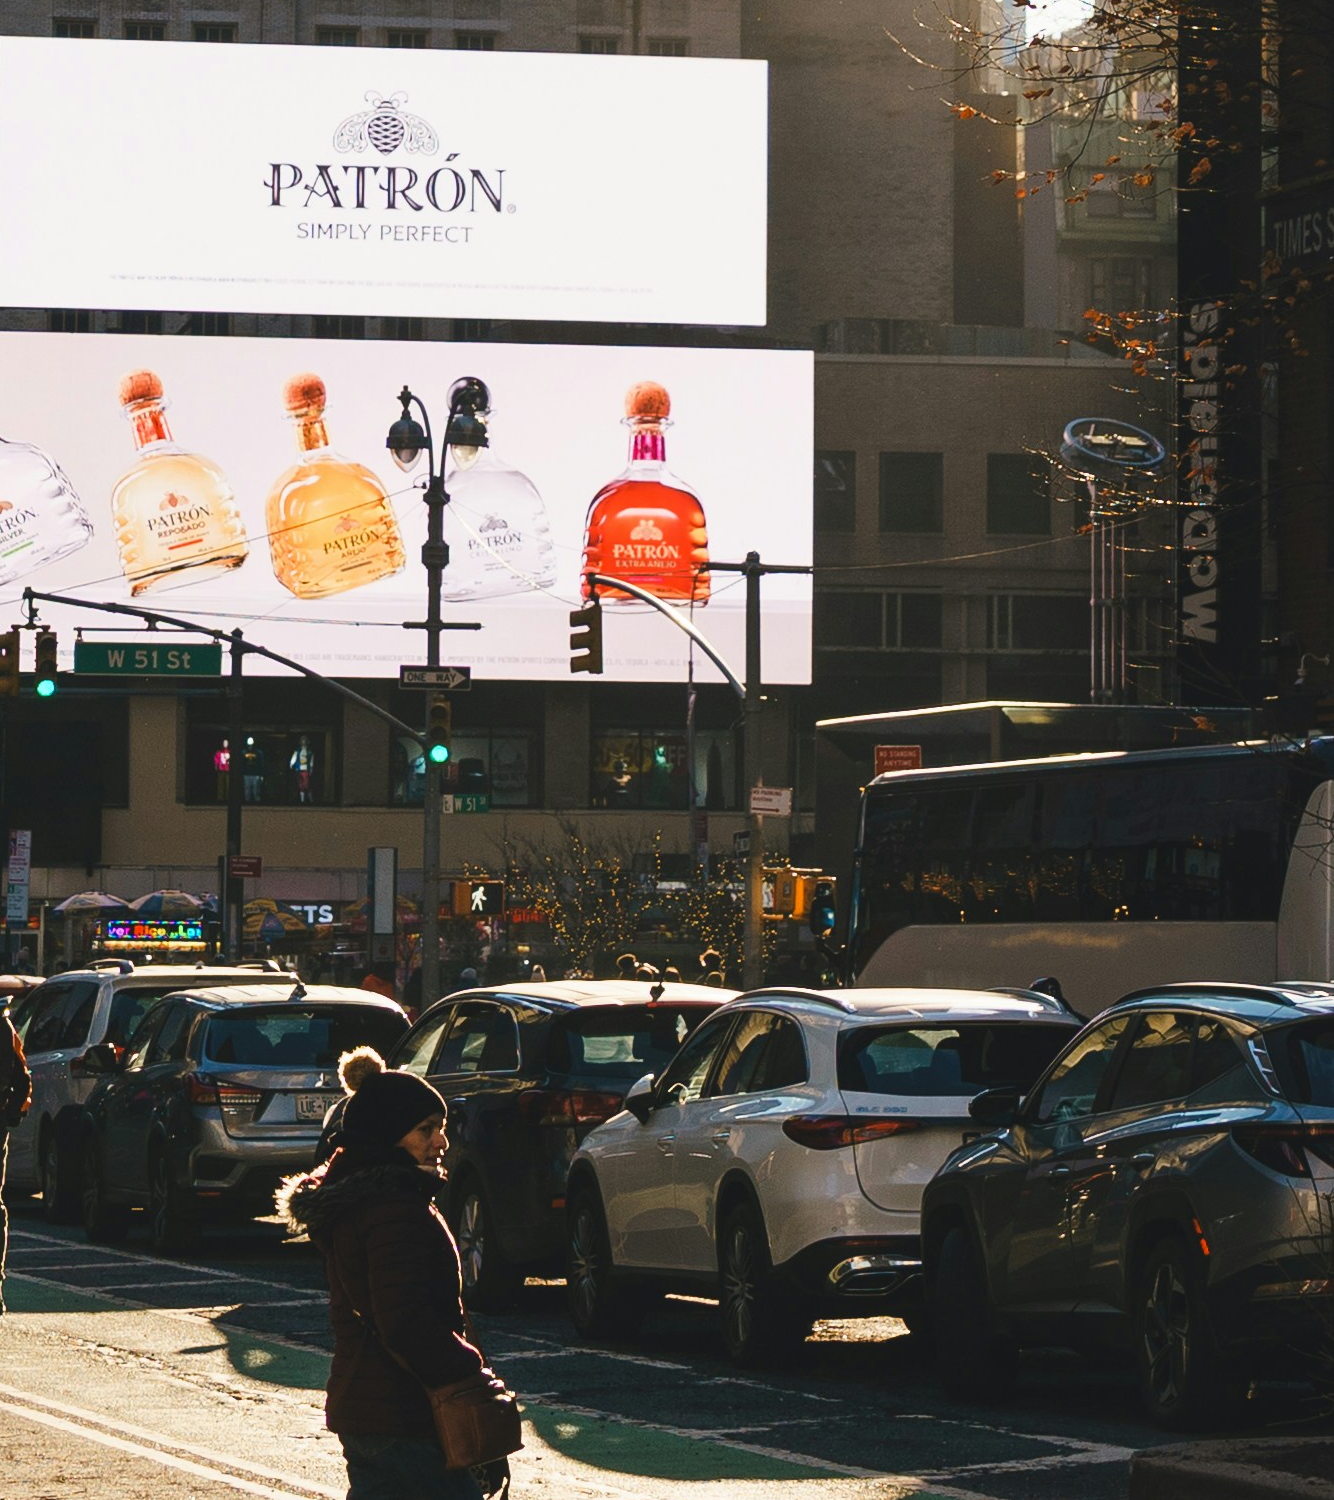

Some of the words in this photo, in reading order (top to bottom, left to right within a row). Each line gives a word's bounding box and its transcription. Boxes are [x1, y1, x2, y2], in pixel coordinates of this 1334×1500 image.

[263, 152, 507, 214] PATRÓN
[296, 221, 372, 241] SIMPLY
[379, 223, 474, 244] PERFECT
[1273, 212, 1322, 259] TIMES
[146, 503, 212, 532] PATRÓN
[157, 520, 207, 538] REPOSADO
[467, 529, 524, 551] PATRÓN
[323, 527, 381, 556] PATRÓN
[611, 542, 680, 559] PATRÓN
[613, 560, 644, 569] EXTRA
[107, 649, 126, 668] W
[133, 649, 158, 669] 51
[167, 650, 192, 670] St
[406, 672, 426, 684] ONE
[435, 672, 457, 685] WAY
